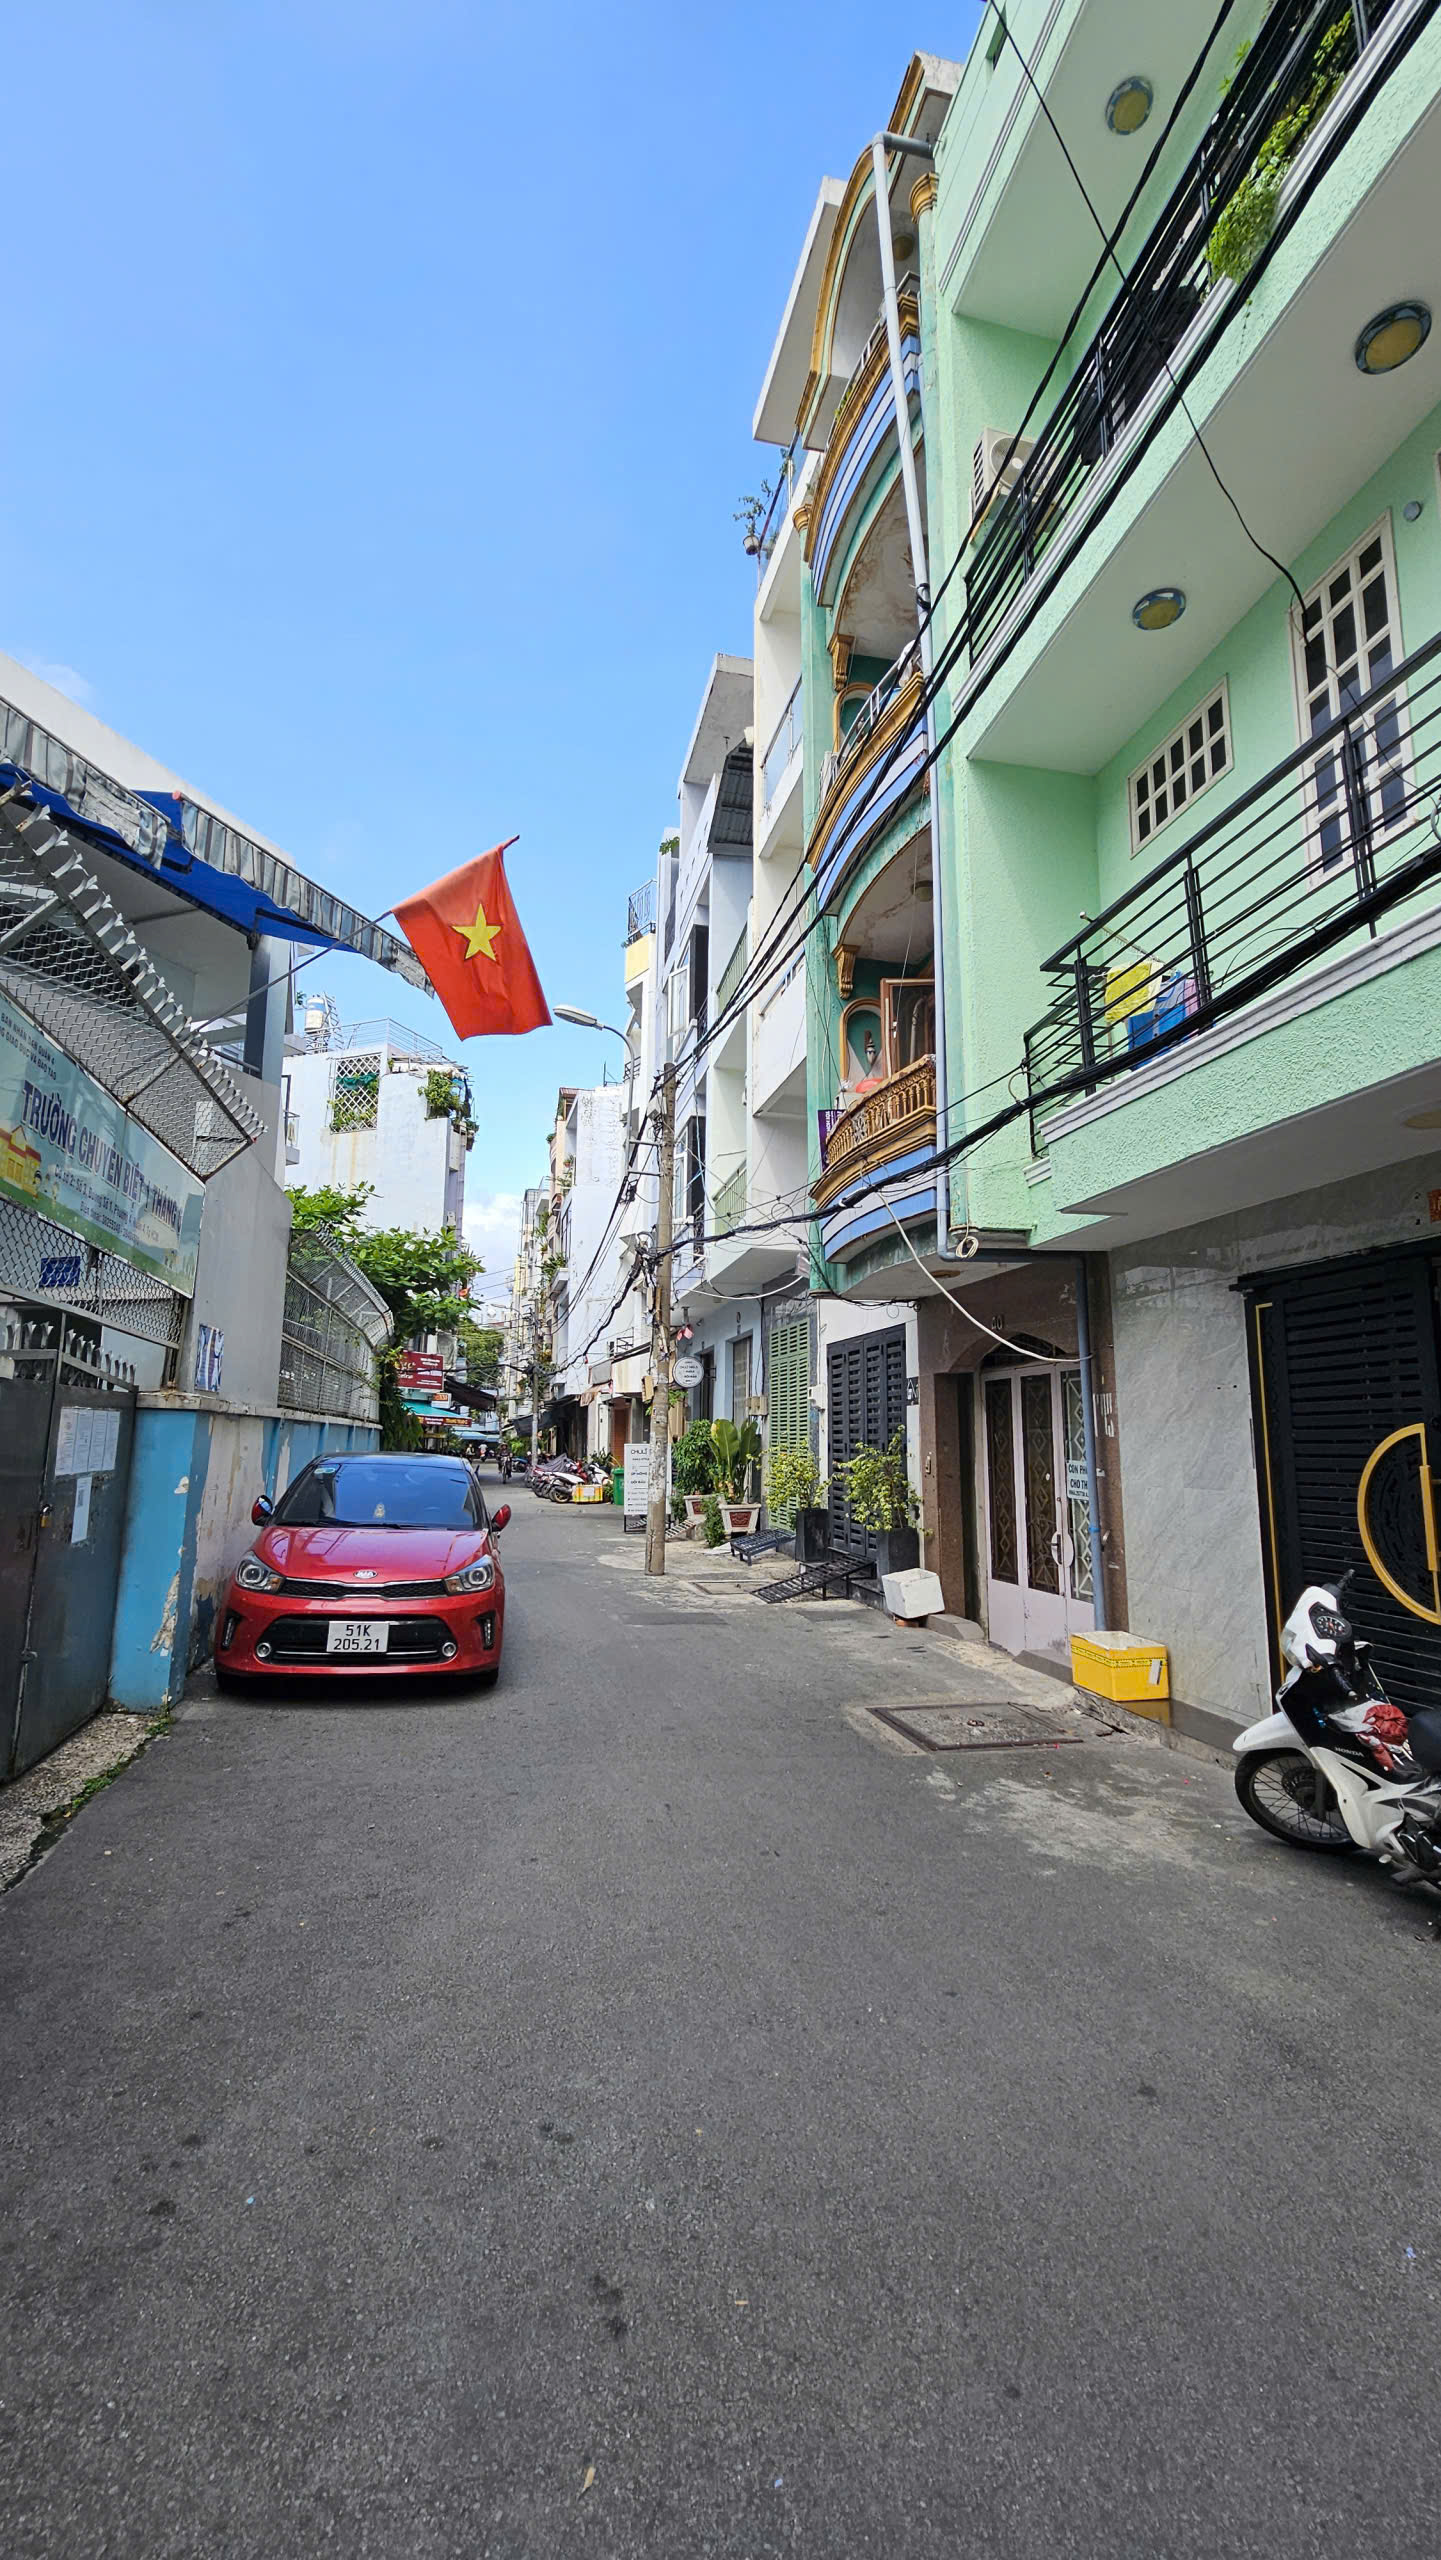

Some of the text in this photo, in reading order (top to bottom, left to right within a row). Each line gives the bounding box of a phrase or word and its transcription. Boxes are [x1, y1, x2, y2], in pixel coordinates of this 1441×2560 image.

[22, 1079, 77, 1157] TRƯỜNG
[78, 1126, 123, 1190] CHUYÊN
[345, 1624, 372, 1637] 51K
[333, 1638, 380, 1651] 205.21
[1334, 1746, 1365, 1758] HONDA
